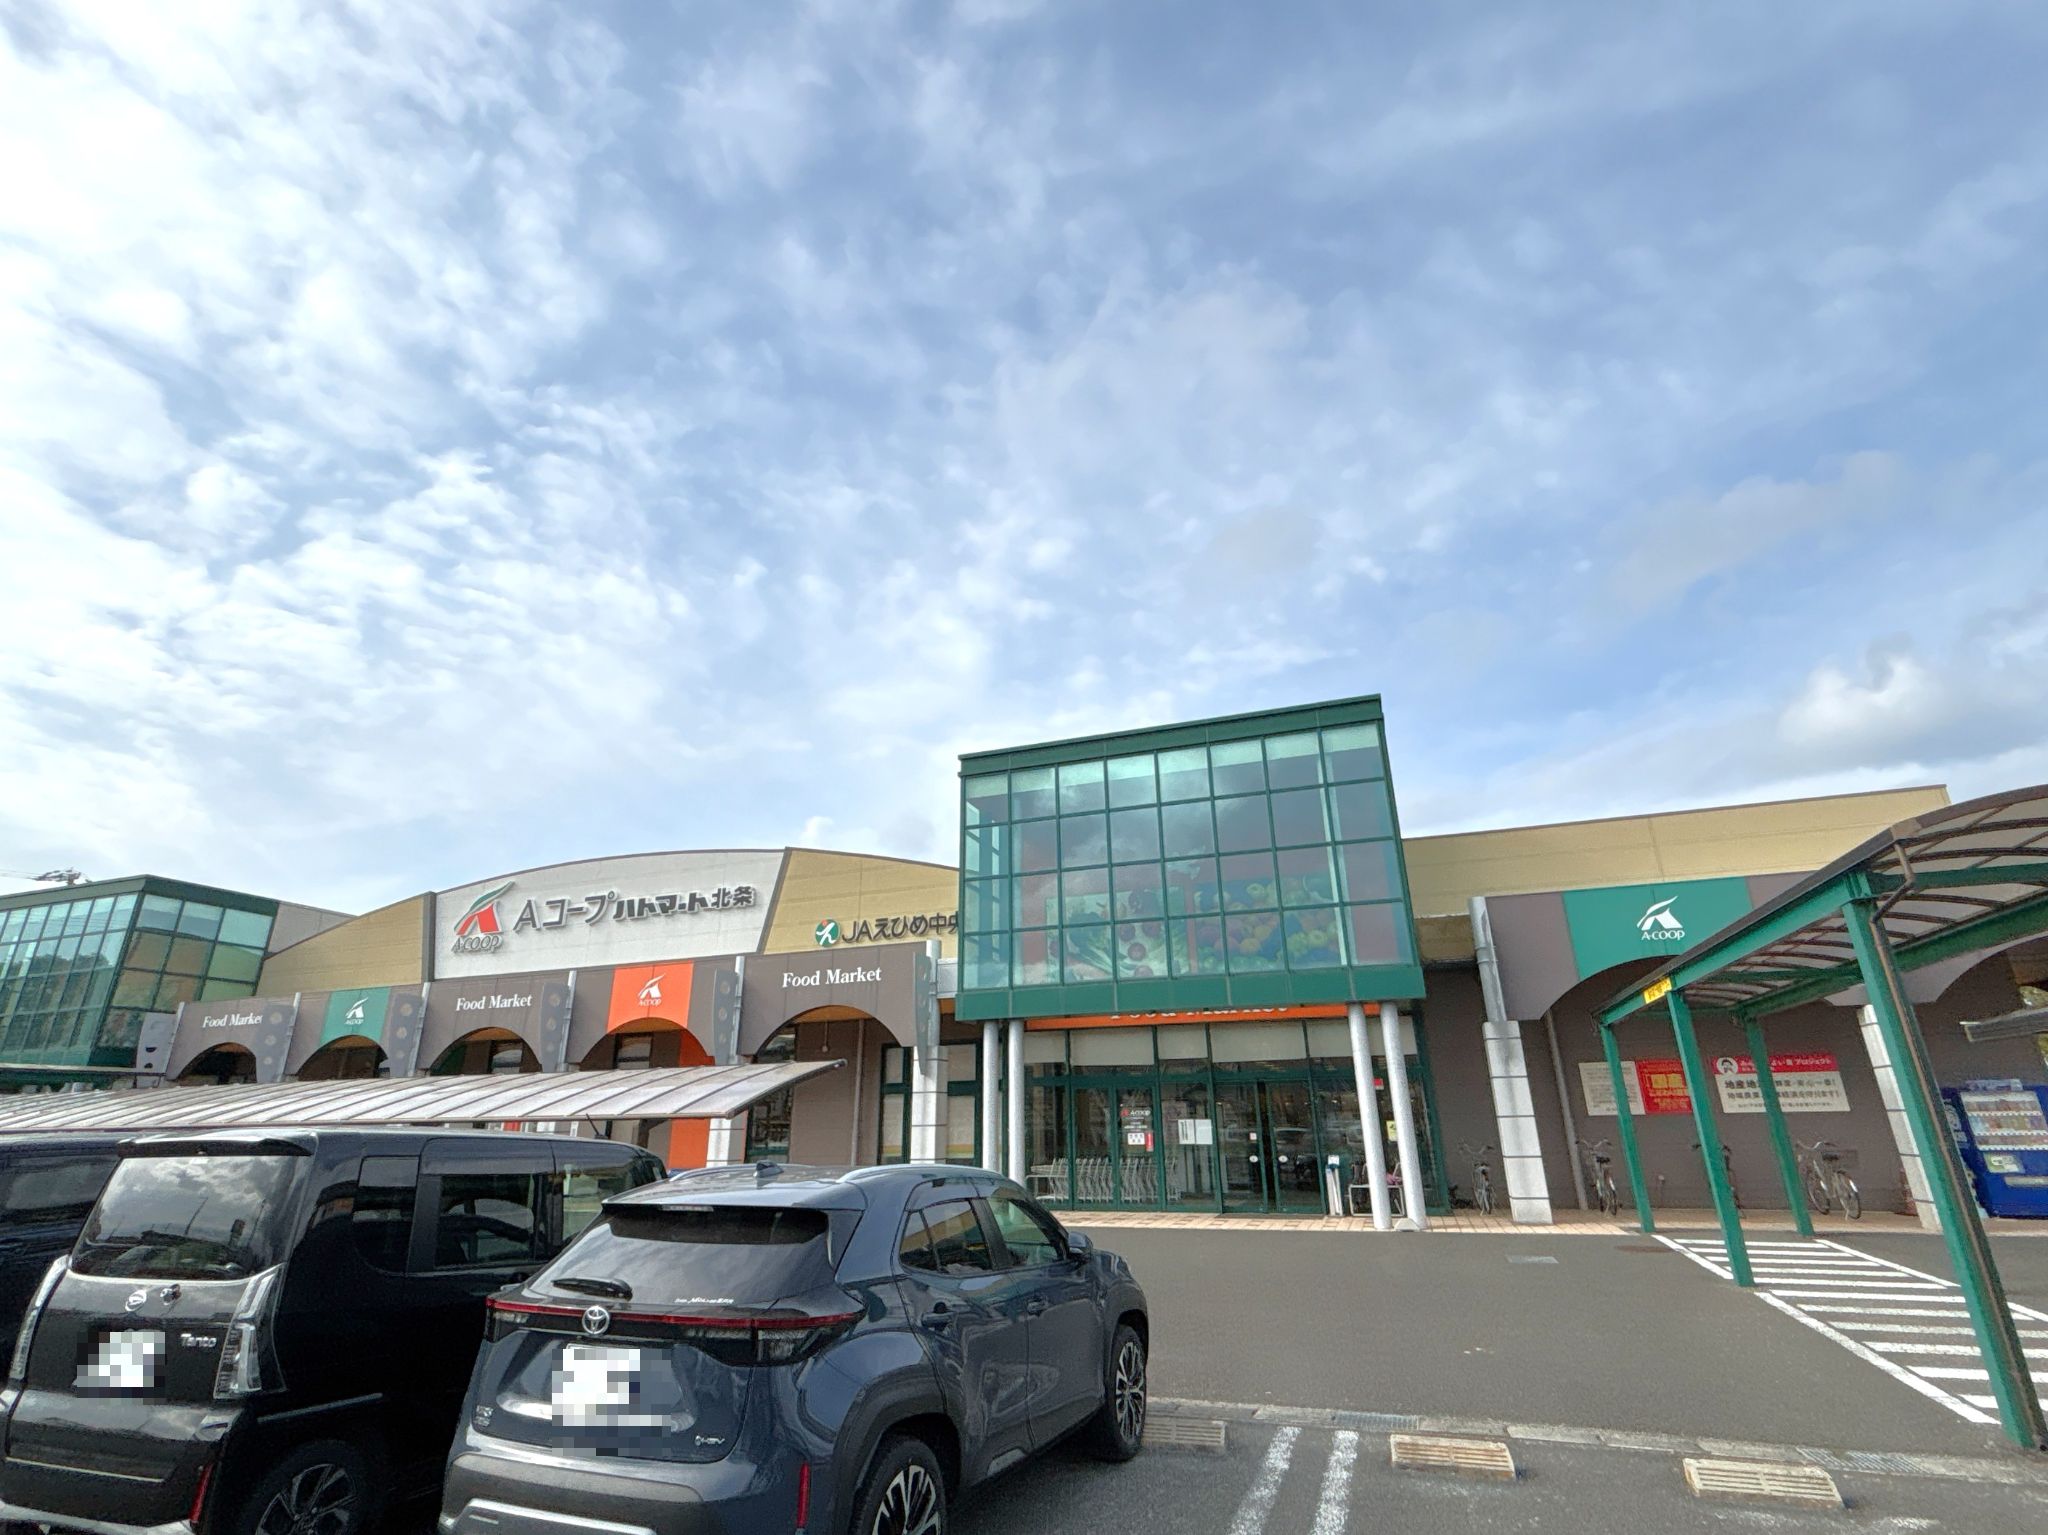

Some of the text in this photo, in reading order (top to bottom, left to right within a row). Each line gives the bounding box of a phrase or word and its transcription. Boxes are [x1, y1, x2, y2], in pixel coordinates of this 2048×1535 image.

[782, 967, 882, 988] Food Market
[456, 994, 533, 1011] Food Market
[202, 1014, 229, 1028] Food
